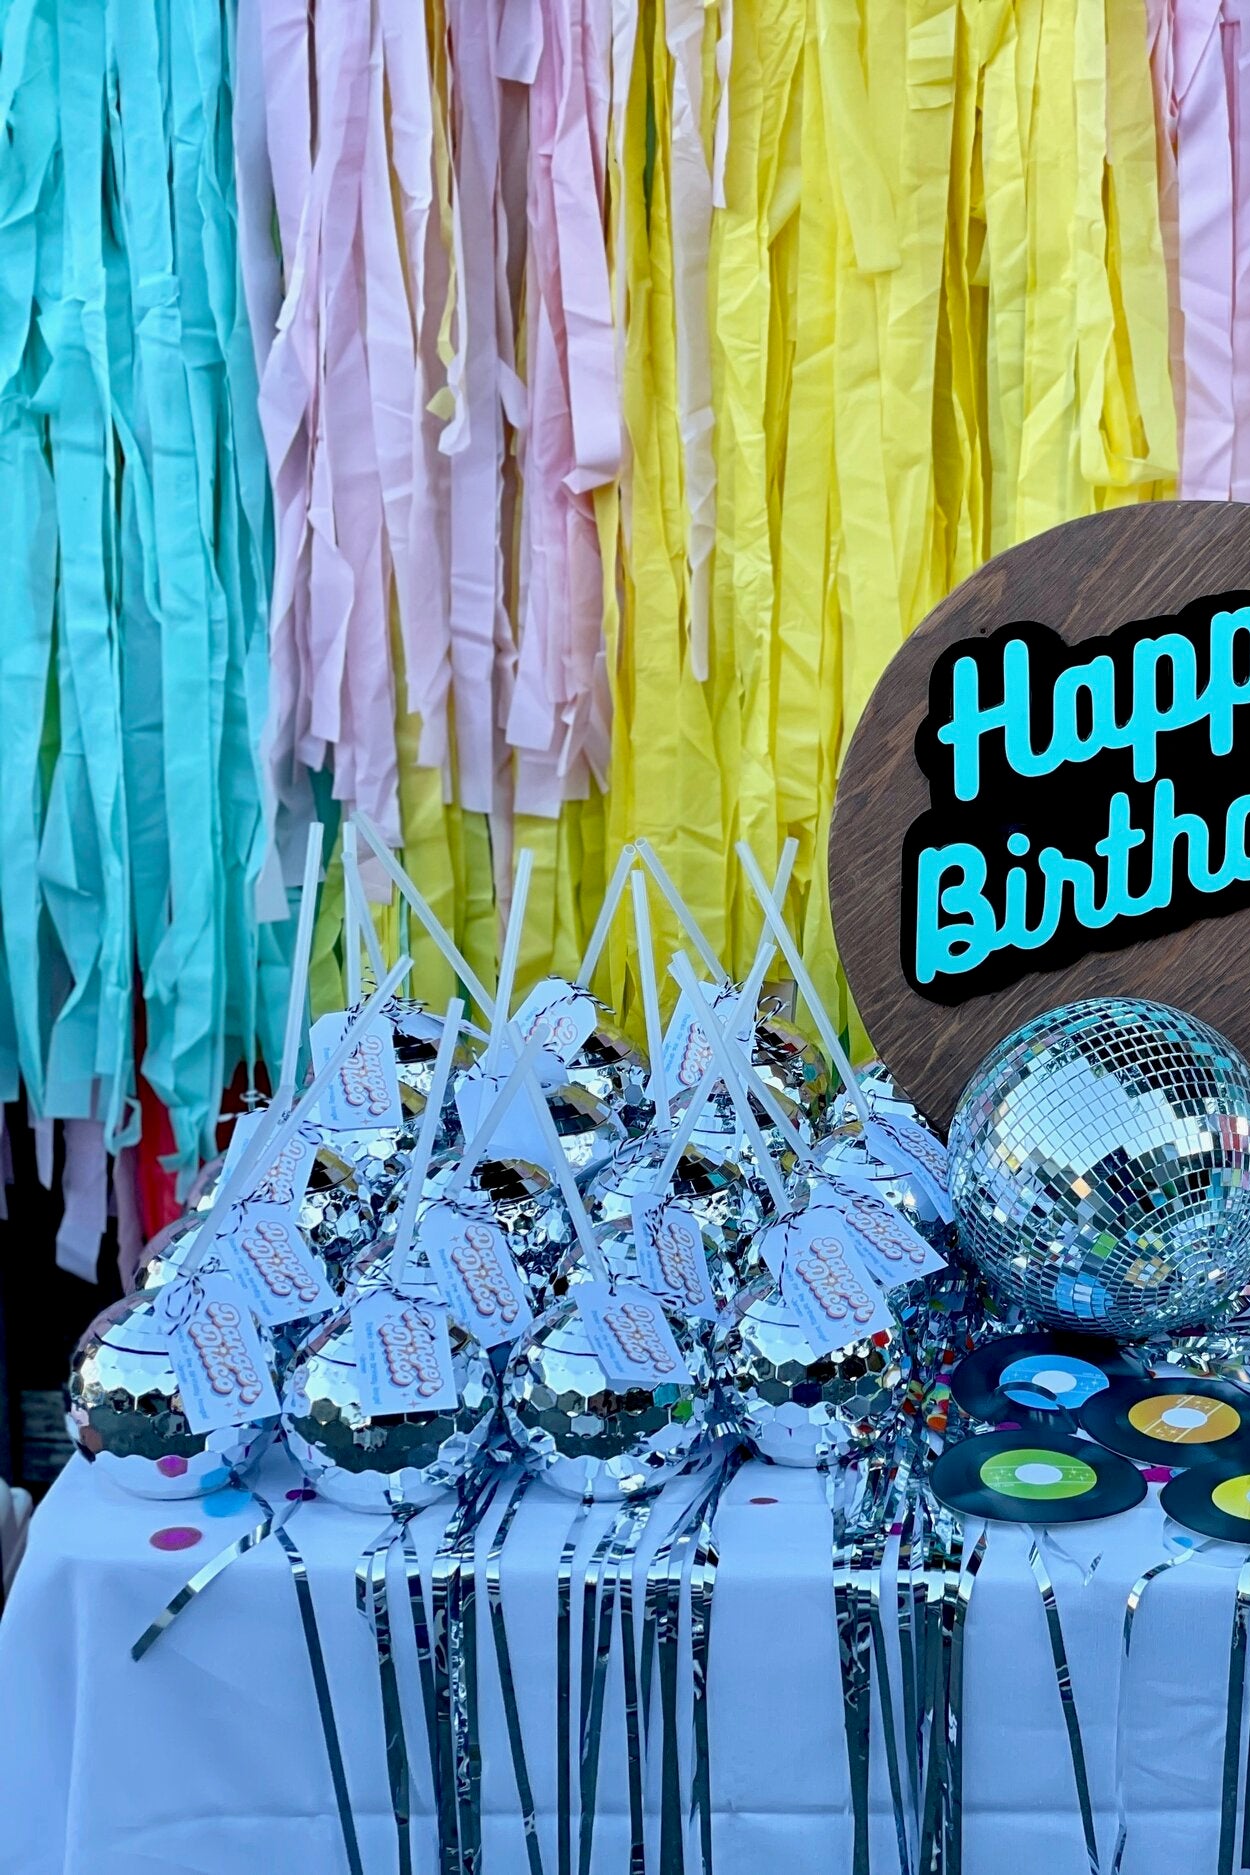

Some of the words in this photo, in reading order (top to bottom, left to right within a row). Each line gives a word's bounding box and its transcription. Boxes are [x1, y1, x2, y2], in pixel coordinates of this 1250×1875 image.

[241, 1237, 293, 1296] Disco
[255, 1220, 320, 1303] Danger
[668, 1222, 705, 1306] Danger
[846, 1212, 903, 1260] Disco
[450, 1247, 497, 1317] Disco
[464, 1225, 520, 1323] Danger
[795, 1258, 849, 1320] Disco
[809, 1237, 876, 1323] Danger
[188, 1321, 235, 1395] Disco
[205, 1301, 264, 1405] Danger
[377, 1322, 415, 1388] Disco
[401, 1308, 445, 1398] Danger
[603, 1313, 651, 1364] Disco
[621, 1302, 677, 1374] Danger
